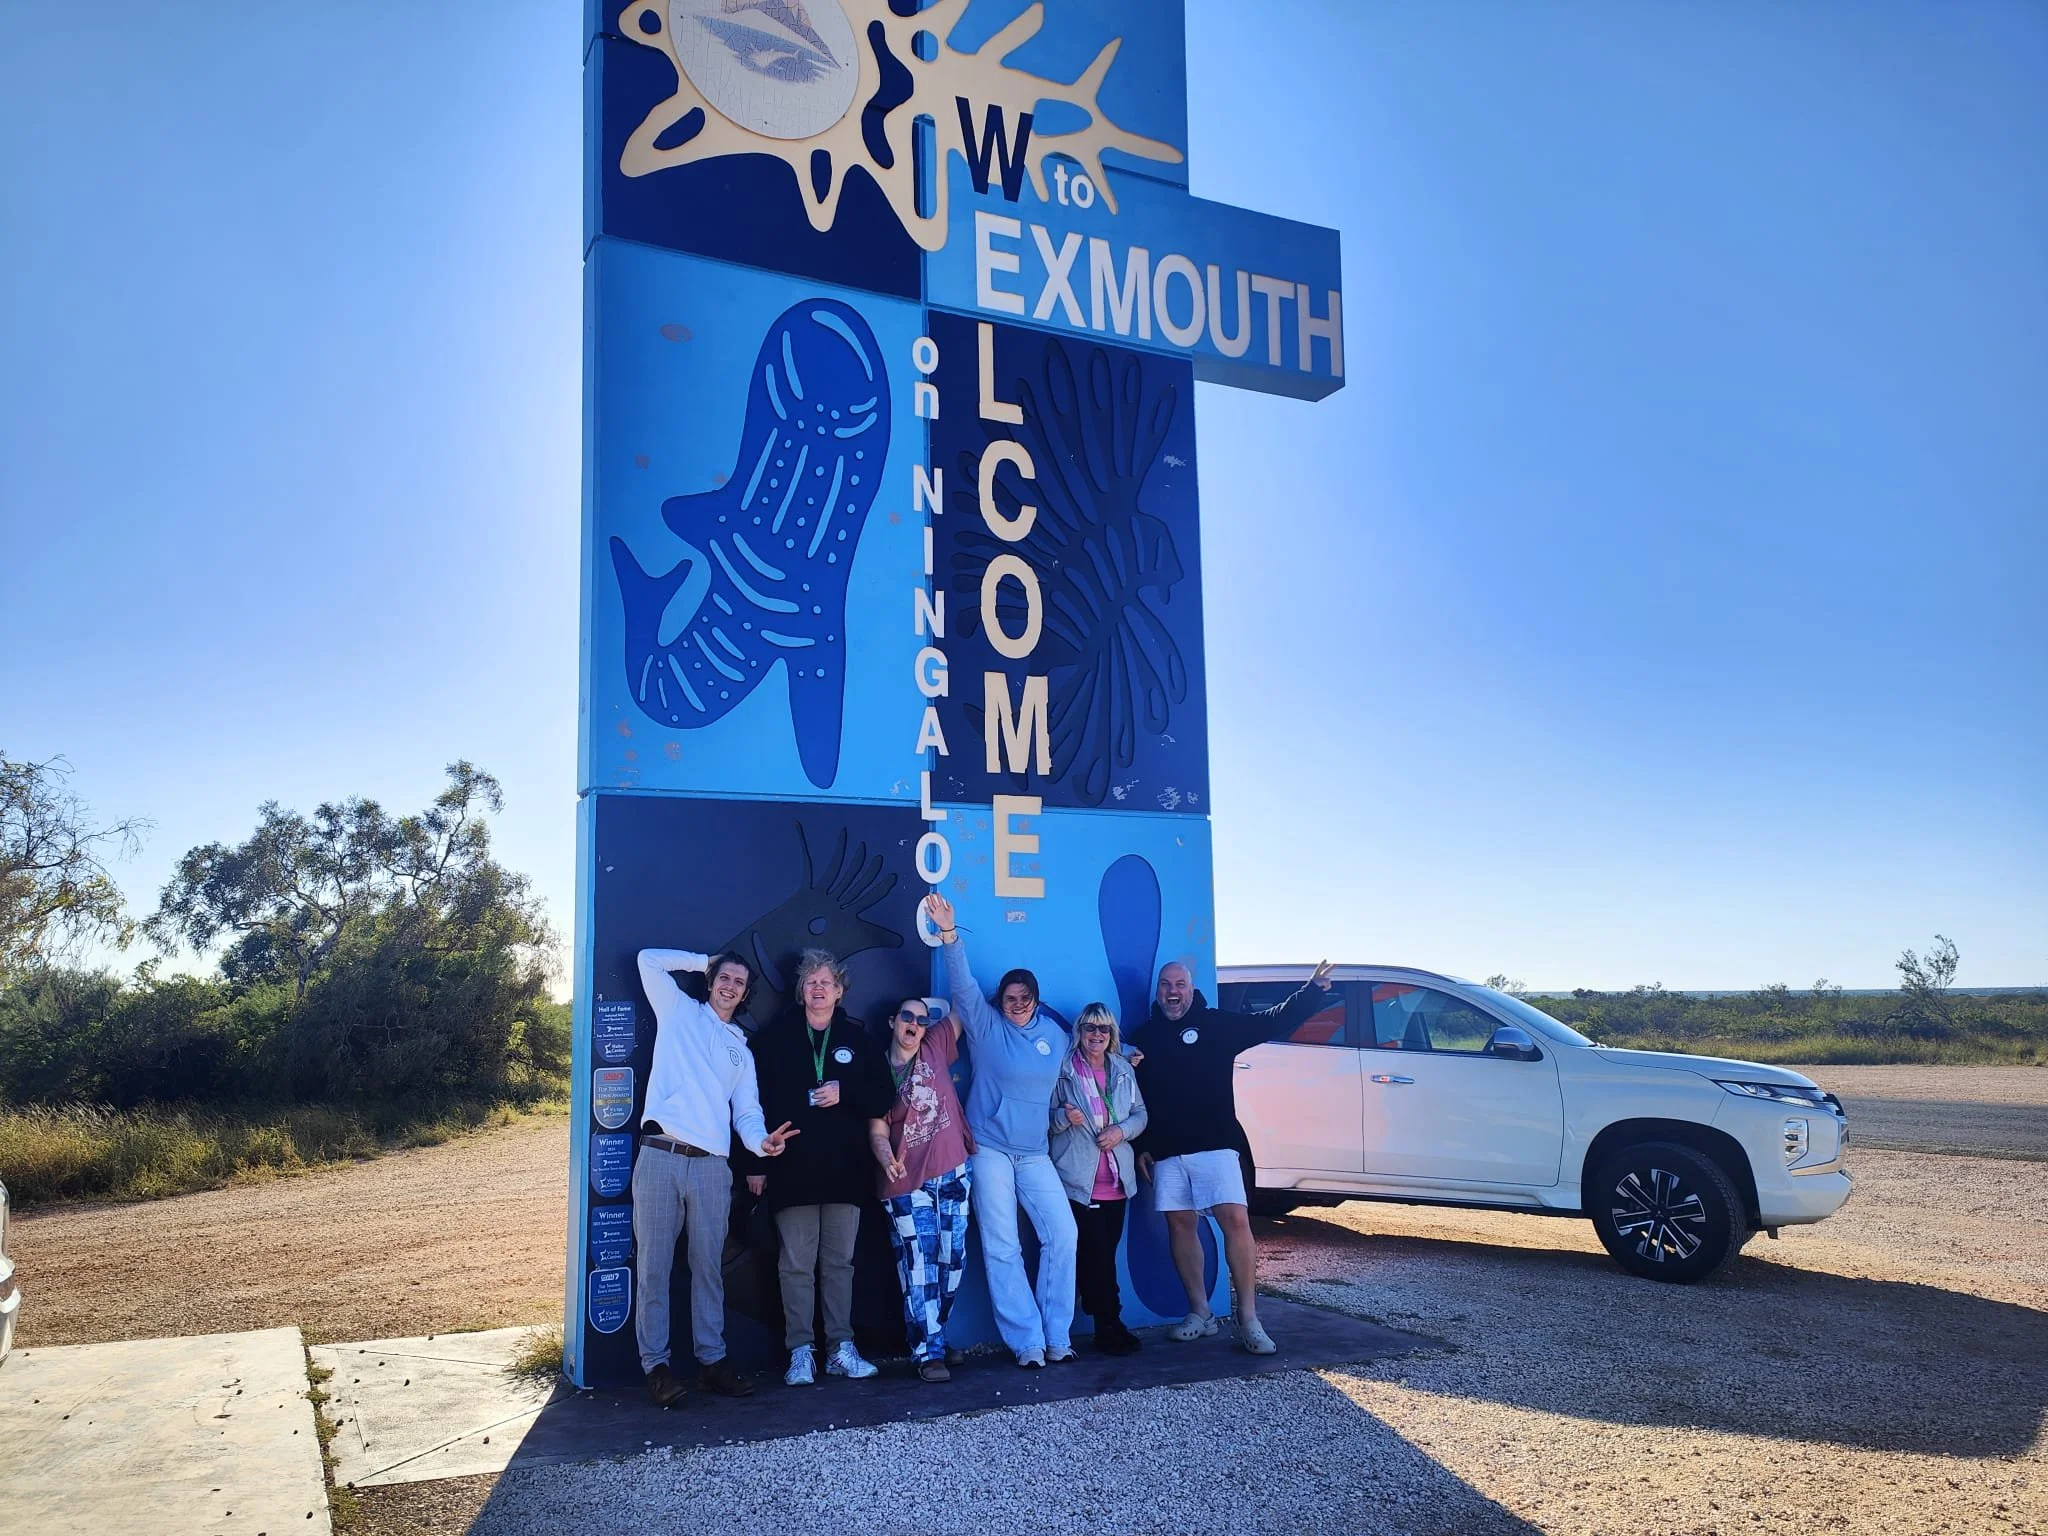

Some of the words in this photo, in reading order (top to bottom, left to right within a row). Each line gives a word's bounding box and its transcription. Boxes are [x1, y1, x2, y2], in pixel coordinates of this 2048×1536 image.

[1053, 163, 1095, 209] to
[974, 209, 1344, 378] EXMOUTH
[911, 335, 940, 420] on
[955, 96, 1051, 899] WELCOME
[599, 1138, 625, 1146] Winner
[599, 1211, 625, 1219] Winner
